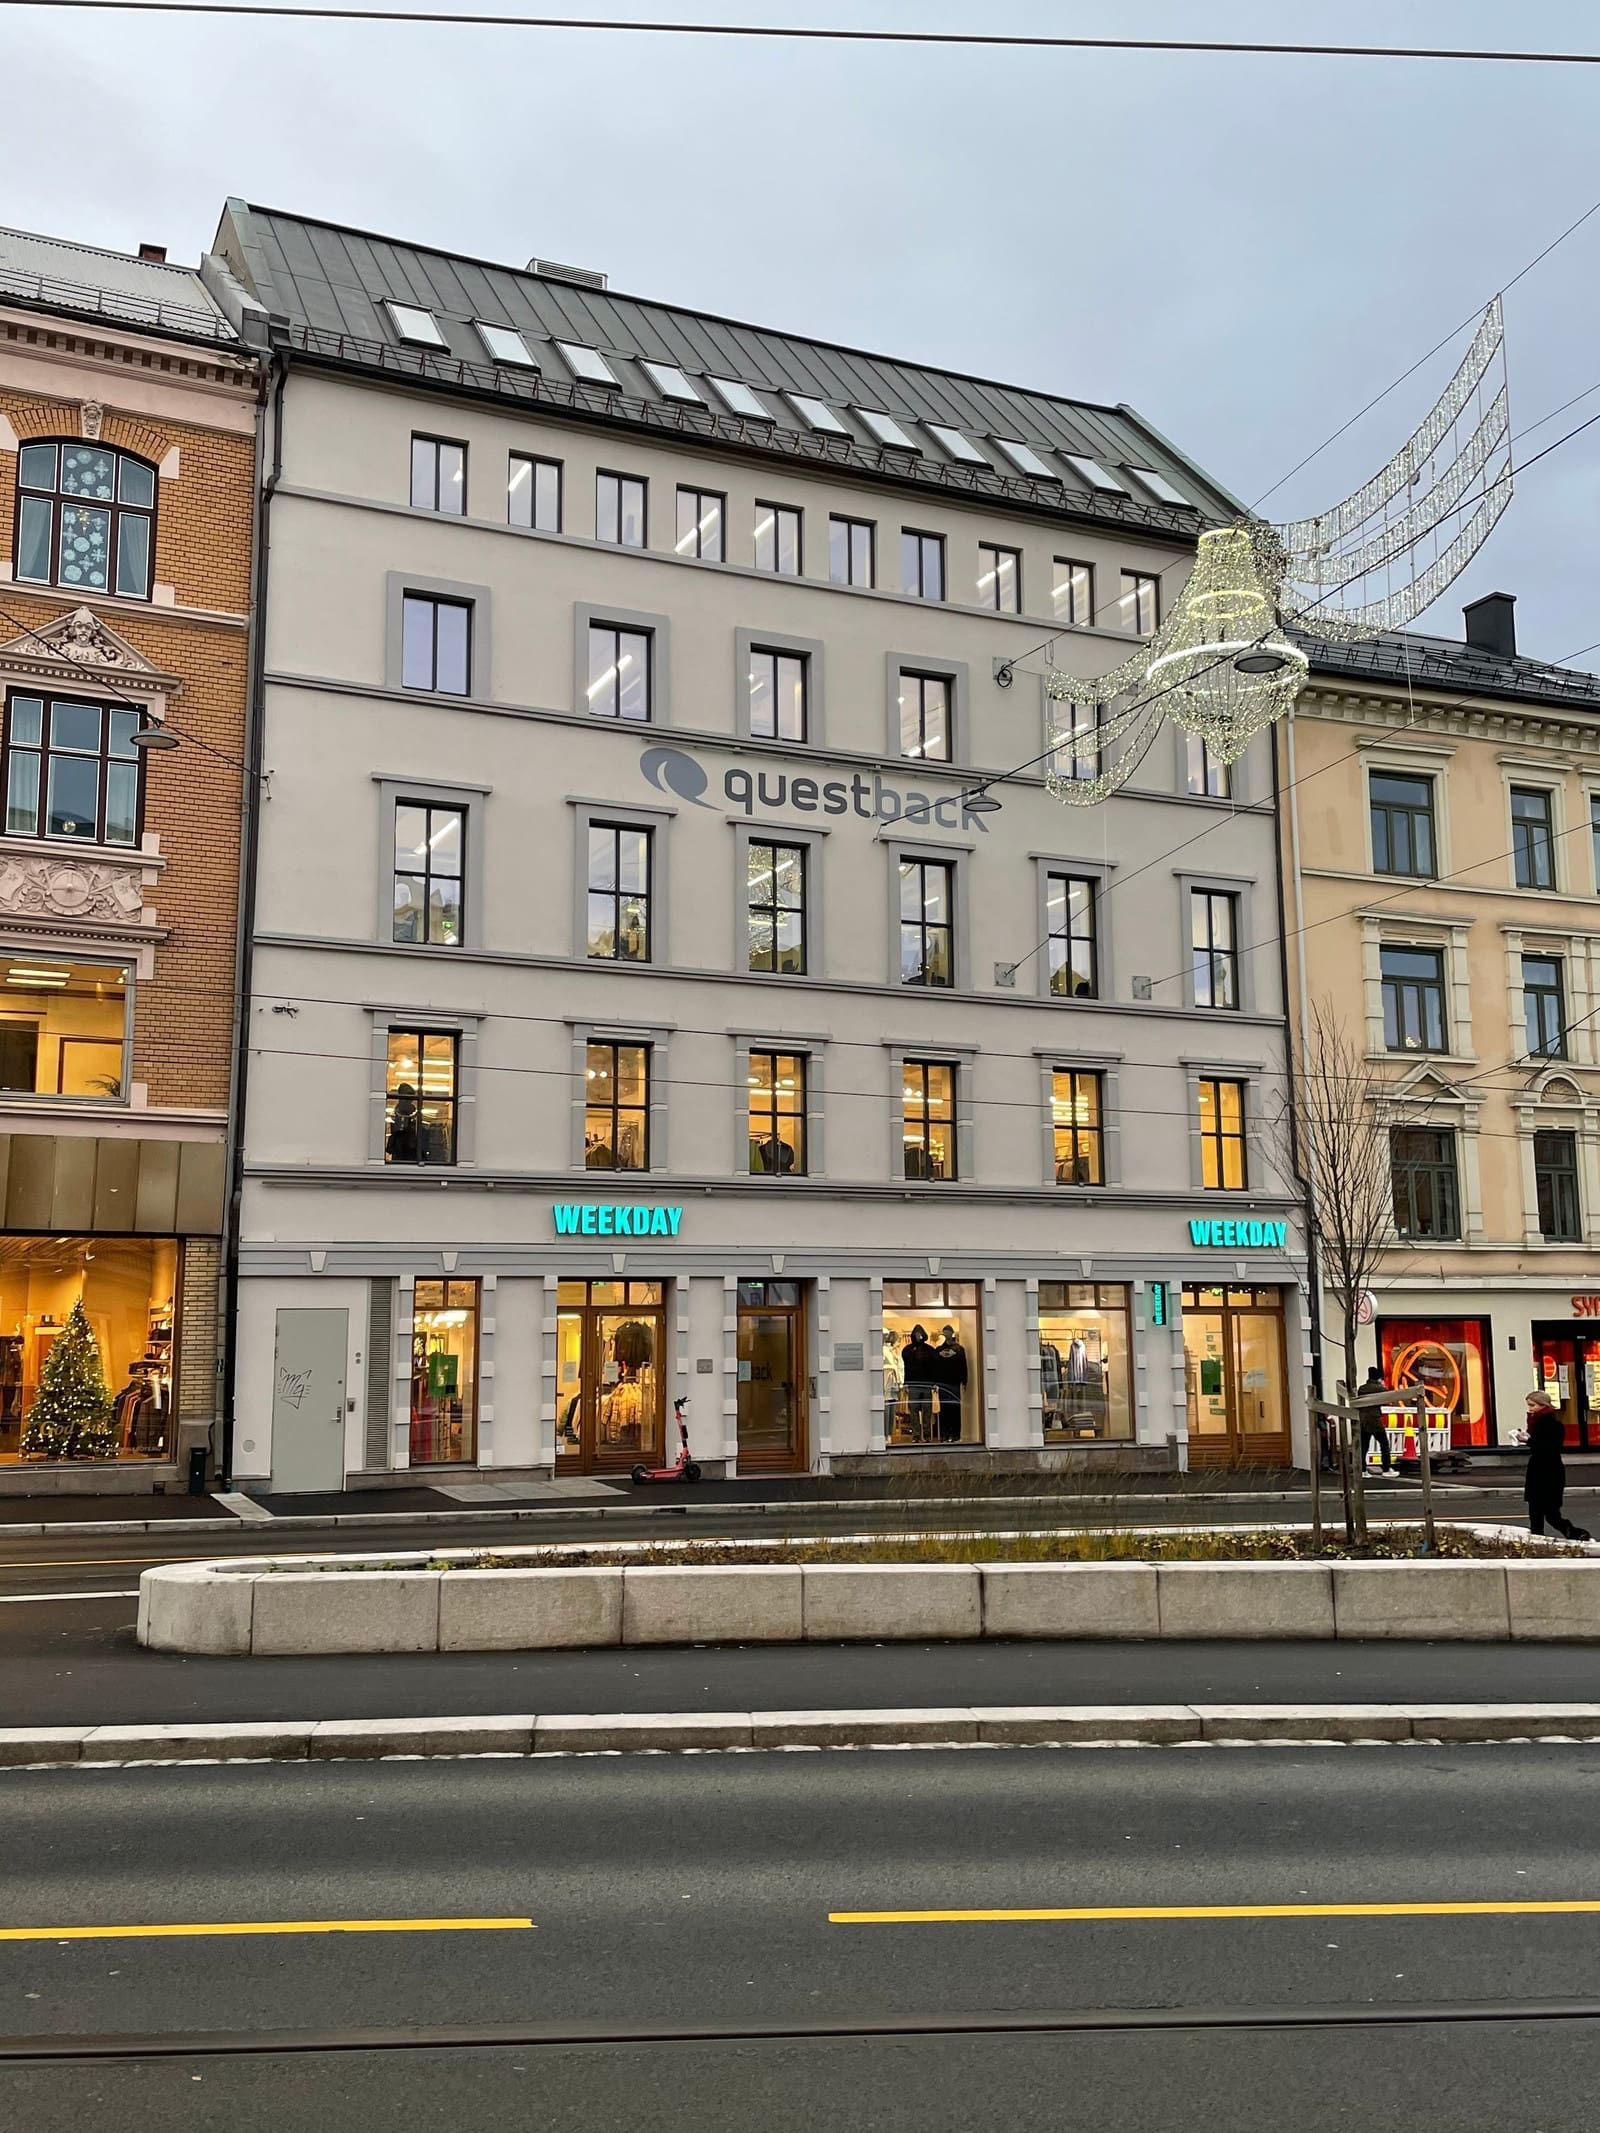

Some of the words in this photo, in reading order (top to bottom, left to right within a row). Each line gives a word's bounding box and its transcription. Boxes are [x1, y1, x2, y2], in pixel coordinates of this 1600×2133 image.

[724, 768, 989, 833] questback
[553, 1203, 683, 1236] WEEKDAY
[1189, 1220, 1287, 1248] WEEKDAY
[1154, 1283, 1163, 1325] WEEKDAY
[40, 1420, 75, 1436] God
